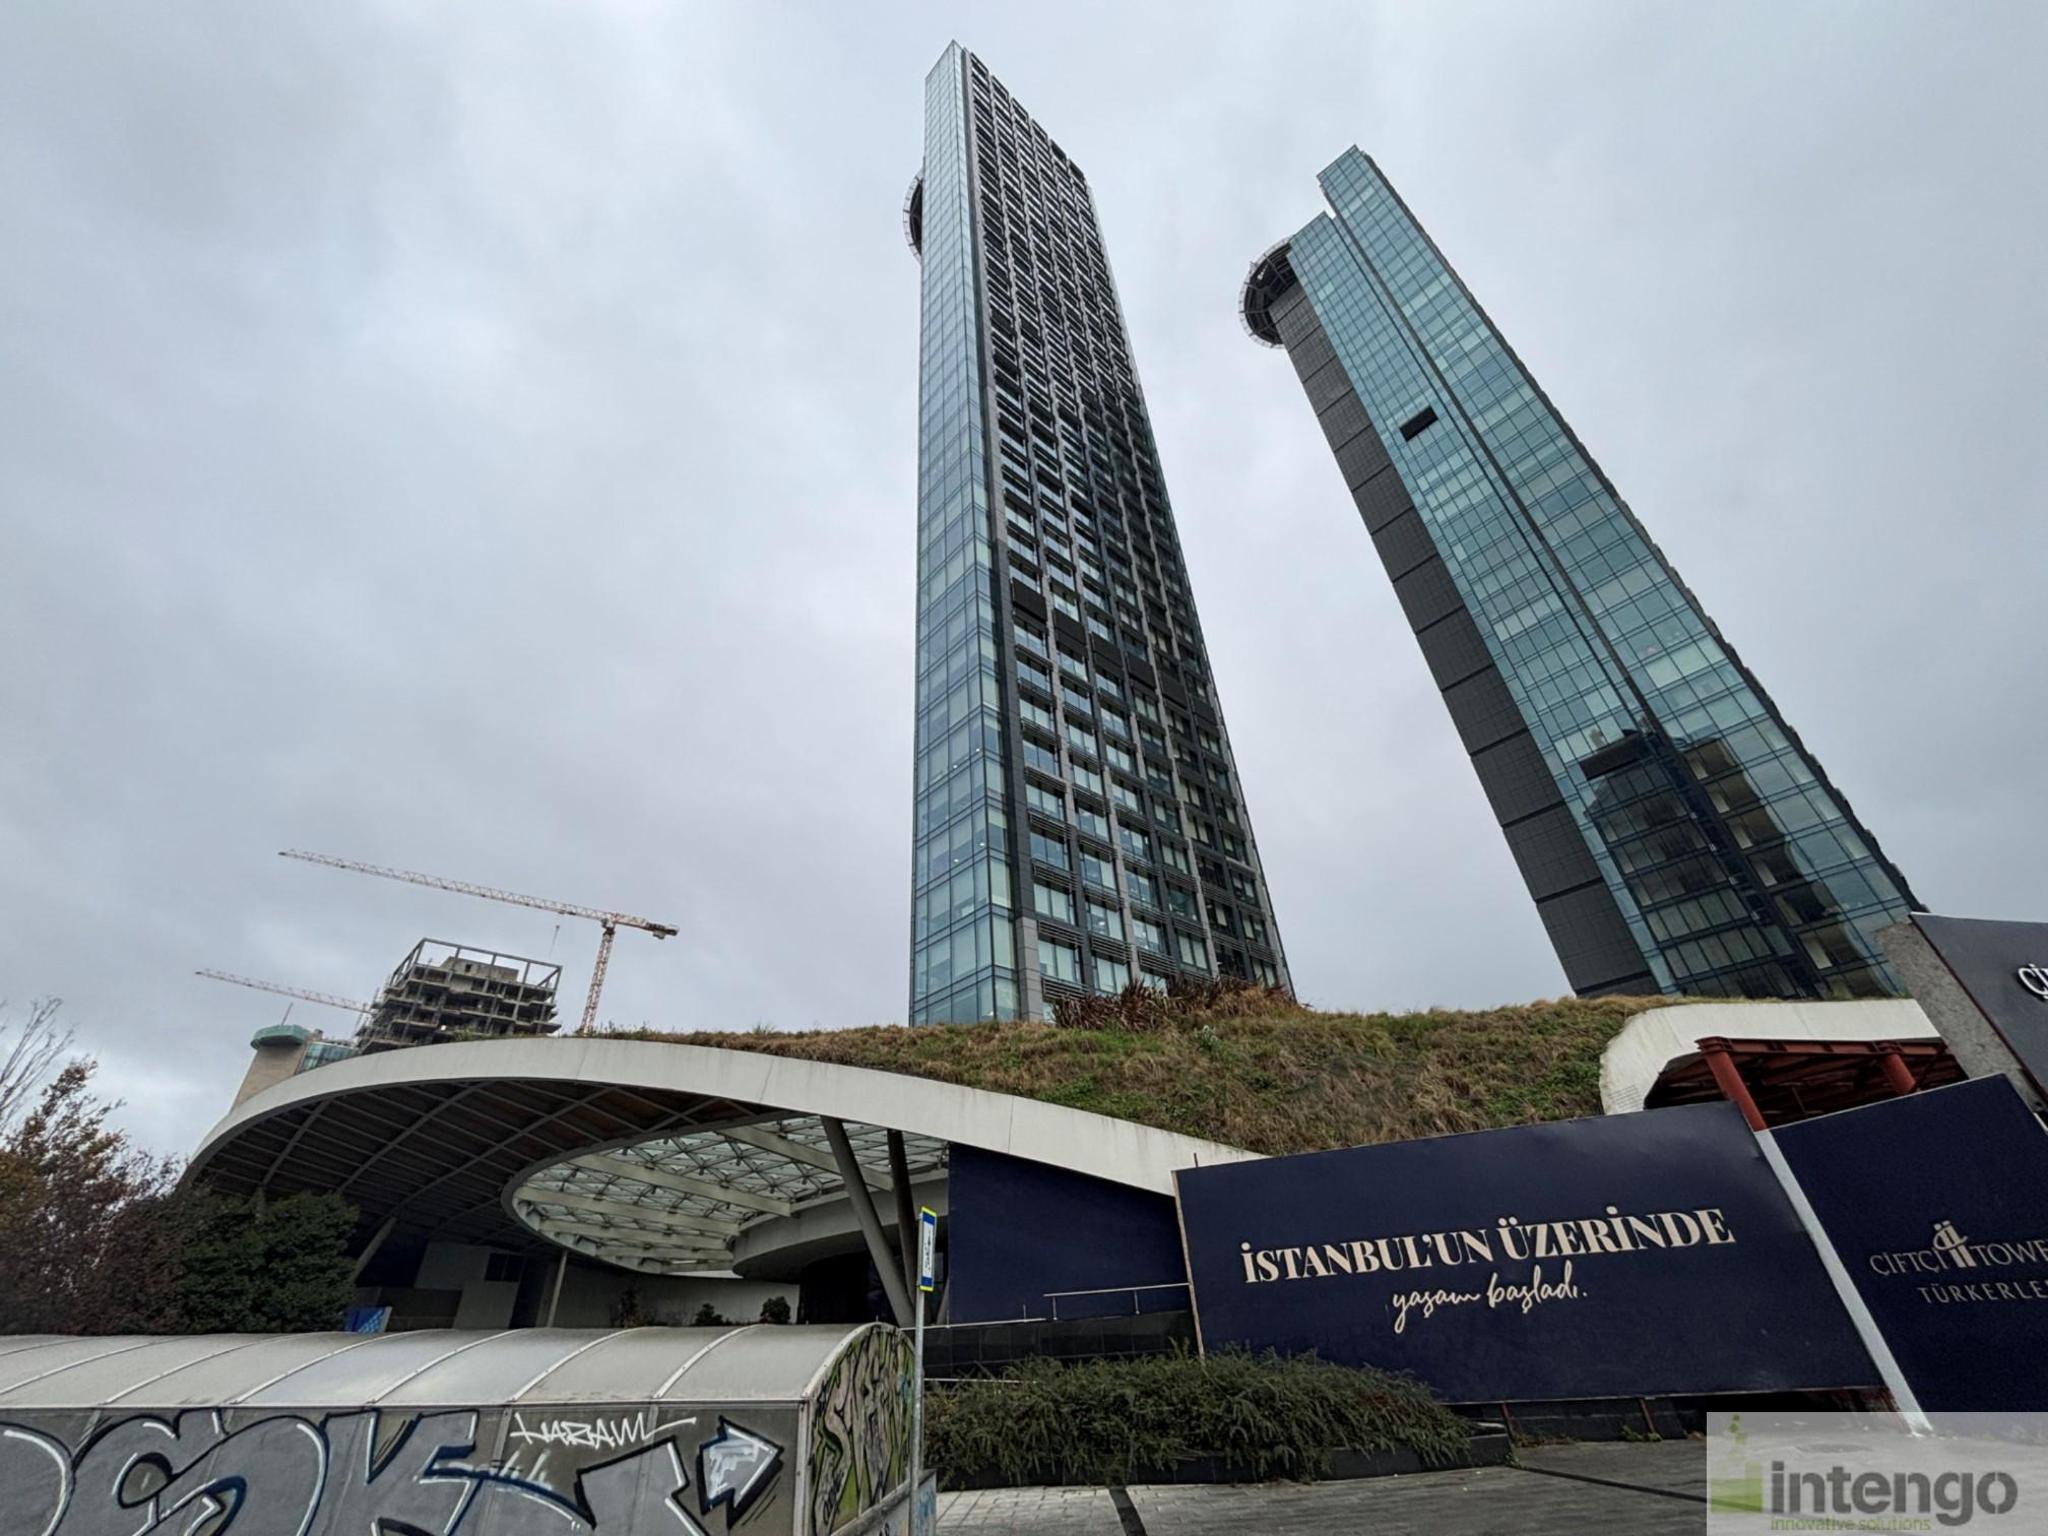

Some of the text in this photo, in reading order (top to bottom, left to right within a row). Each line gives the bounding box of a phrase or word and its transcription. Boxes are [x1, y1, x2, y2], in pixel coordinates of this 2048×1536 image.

[1240, 1206, 1737, 1283] İSTANBUL'UN ÜZERİNDE
[1392, 1289, 1481, 1334] yaşam
[1917, 1281, 2048, 1304] TÜRKERLE
